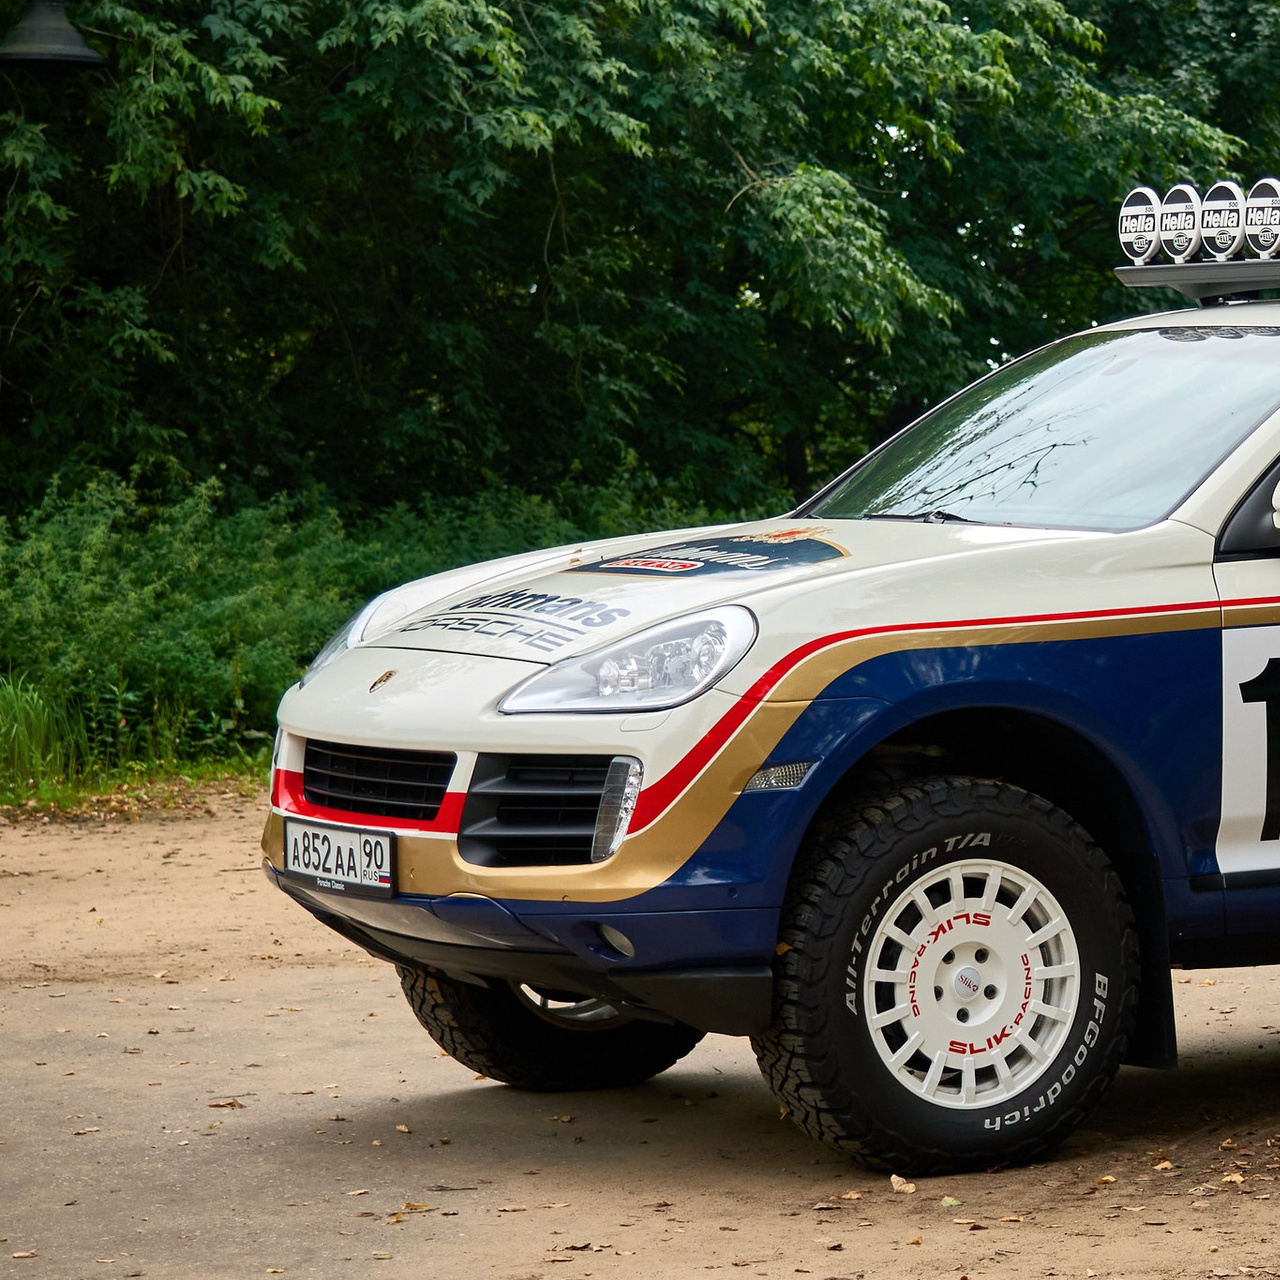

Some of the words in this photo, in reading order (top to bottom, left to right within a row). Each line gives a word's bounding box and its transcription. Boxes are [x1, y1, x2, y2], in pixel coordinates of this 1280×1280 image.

[1121, 215, 1155, 233] Hella
[1161, 212, 1194, 231] Hella
[1202, 210, 1239, 228] Hella
[1246, 207, 1280, 225] Hella
[449, 588, 632, 628] othmans
[399, 617, 574, 652] ORSCHE
[292, 831, 357, 878] A852AA
[363, 838, 384, 870] 90
[362, 869, 379, 882] RUS
[845, 846, 938, 1015] All-Terrain
[944, 832, 992, 853] T/A
[928, 913, 991, 944] SLIK
[948, 1025, 1012, 1055] SLIK
[1014, 953, 1032, 1025] RACING
[984, 971, 1109, 1131] BFGoodrich
